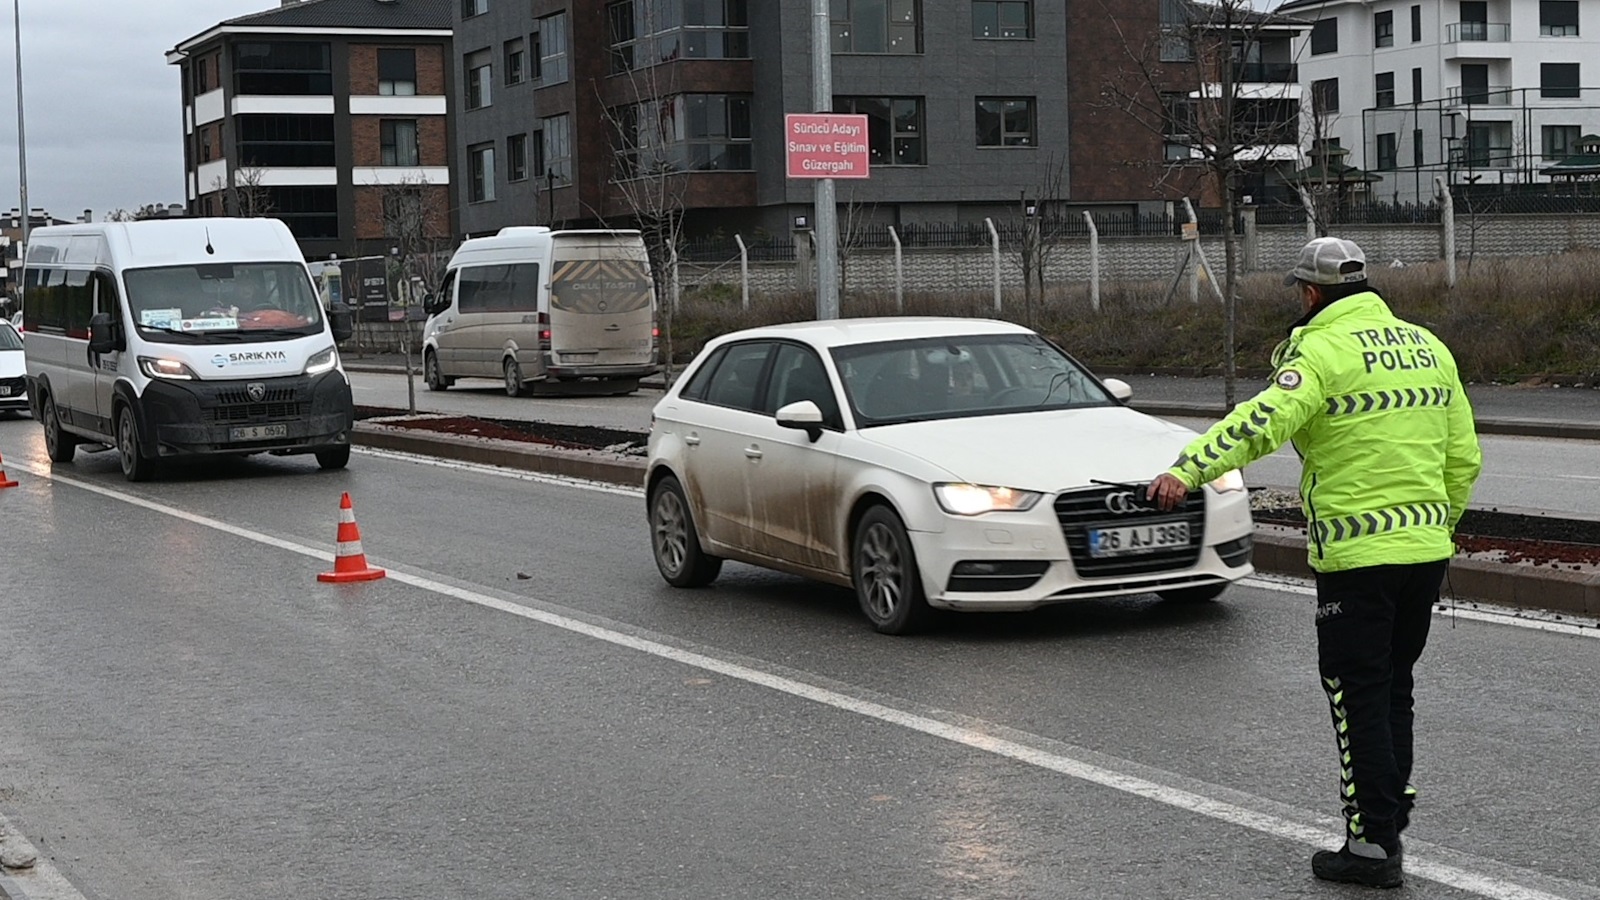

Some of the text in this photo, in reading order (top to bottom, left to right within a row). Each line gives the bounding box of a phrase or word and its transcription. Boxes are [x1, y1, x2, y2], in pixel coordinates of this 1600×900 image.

[793, 122, 860, 136] Sürücü Adayı
[788, 141, 866, 155] Sınav ve Eğitim
[802, 159, 853, 172] Güzergahı
[229, 351, 286, 361] SARIKAYA
[252, 427, 258, 437] S
[1100, 524, 1187, 549] 26 AJ 398
